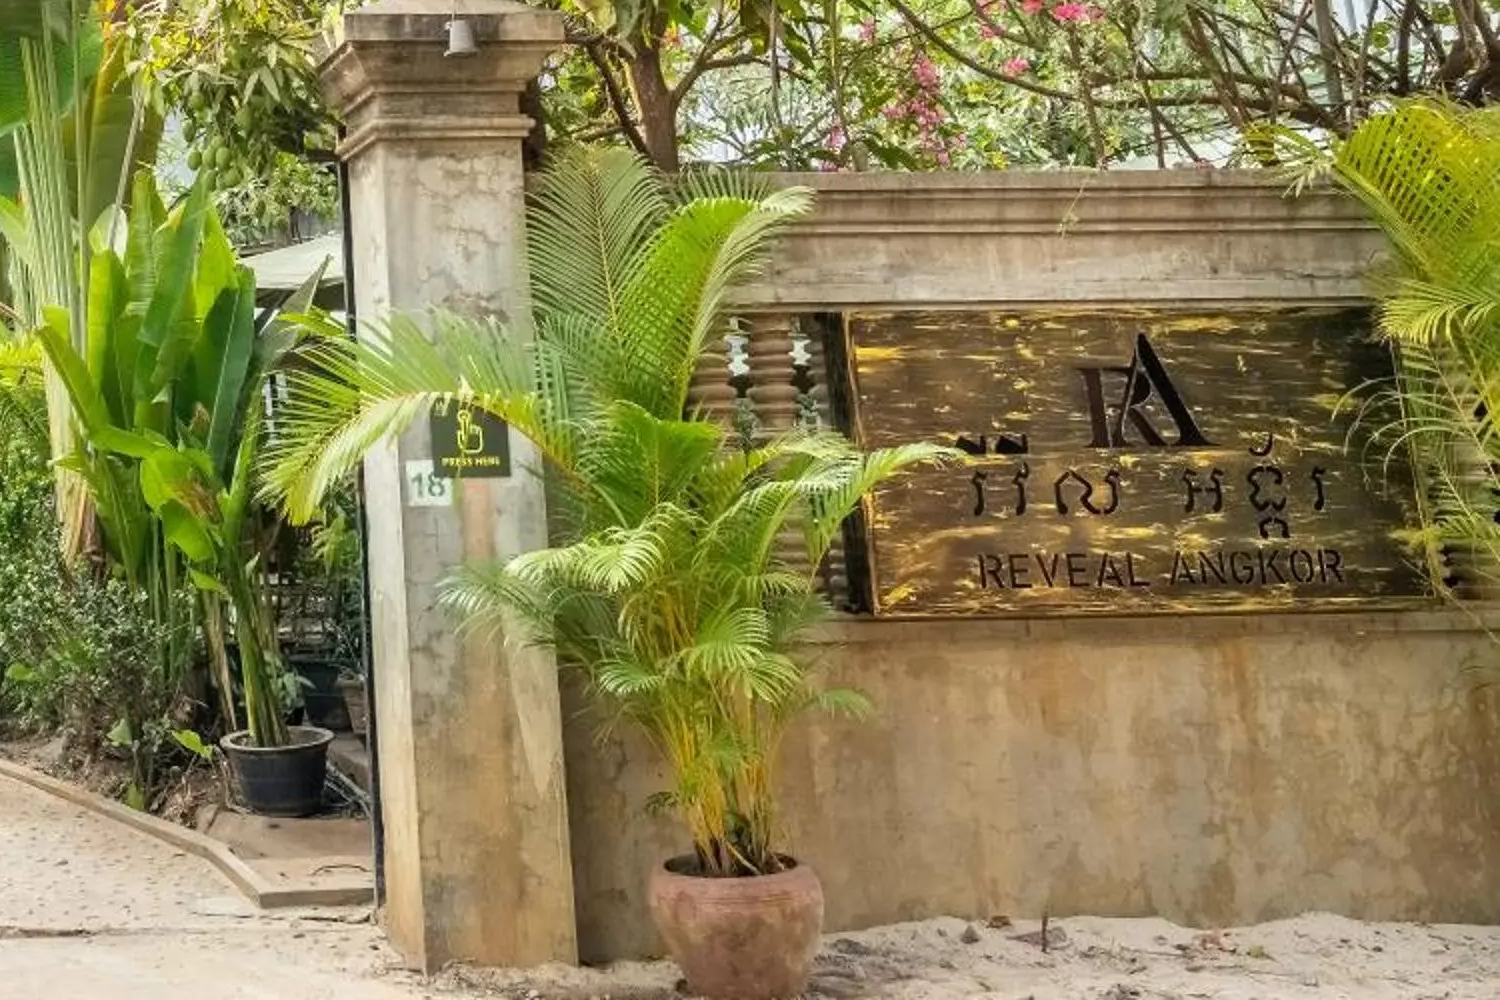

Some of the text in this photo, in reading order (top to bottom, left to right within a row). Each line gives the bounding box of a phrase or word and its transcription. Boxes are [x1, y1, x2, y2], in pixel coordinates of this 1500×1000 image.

[411, 472, 446, 497] 18
[979, 548, 1346, 589] REVEAL ANGKOR
